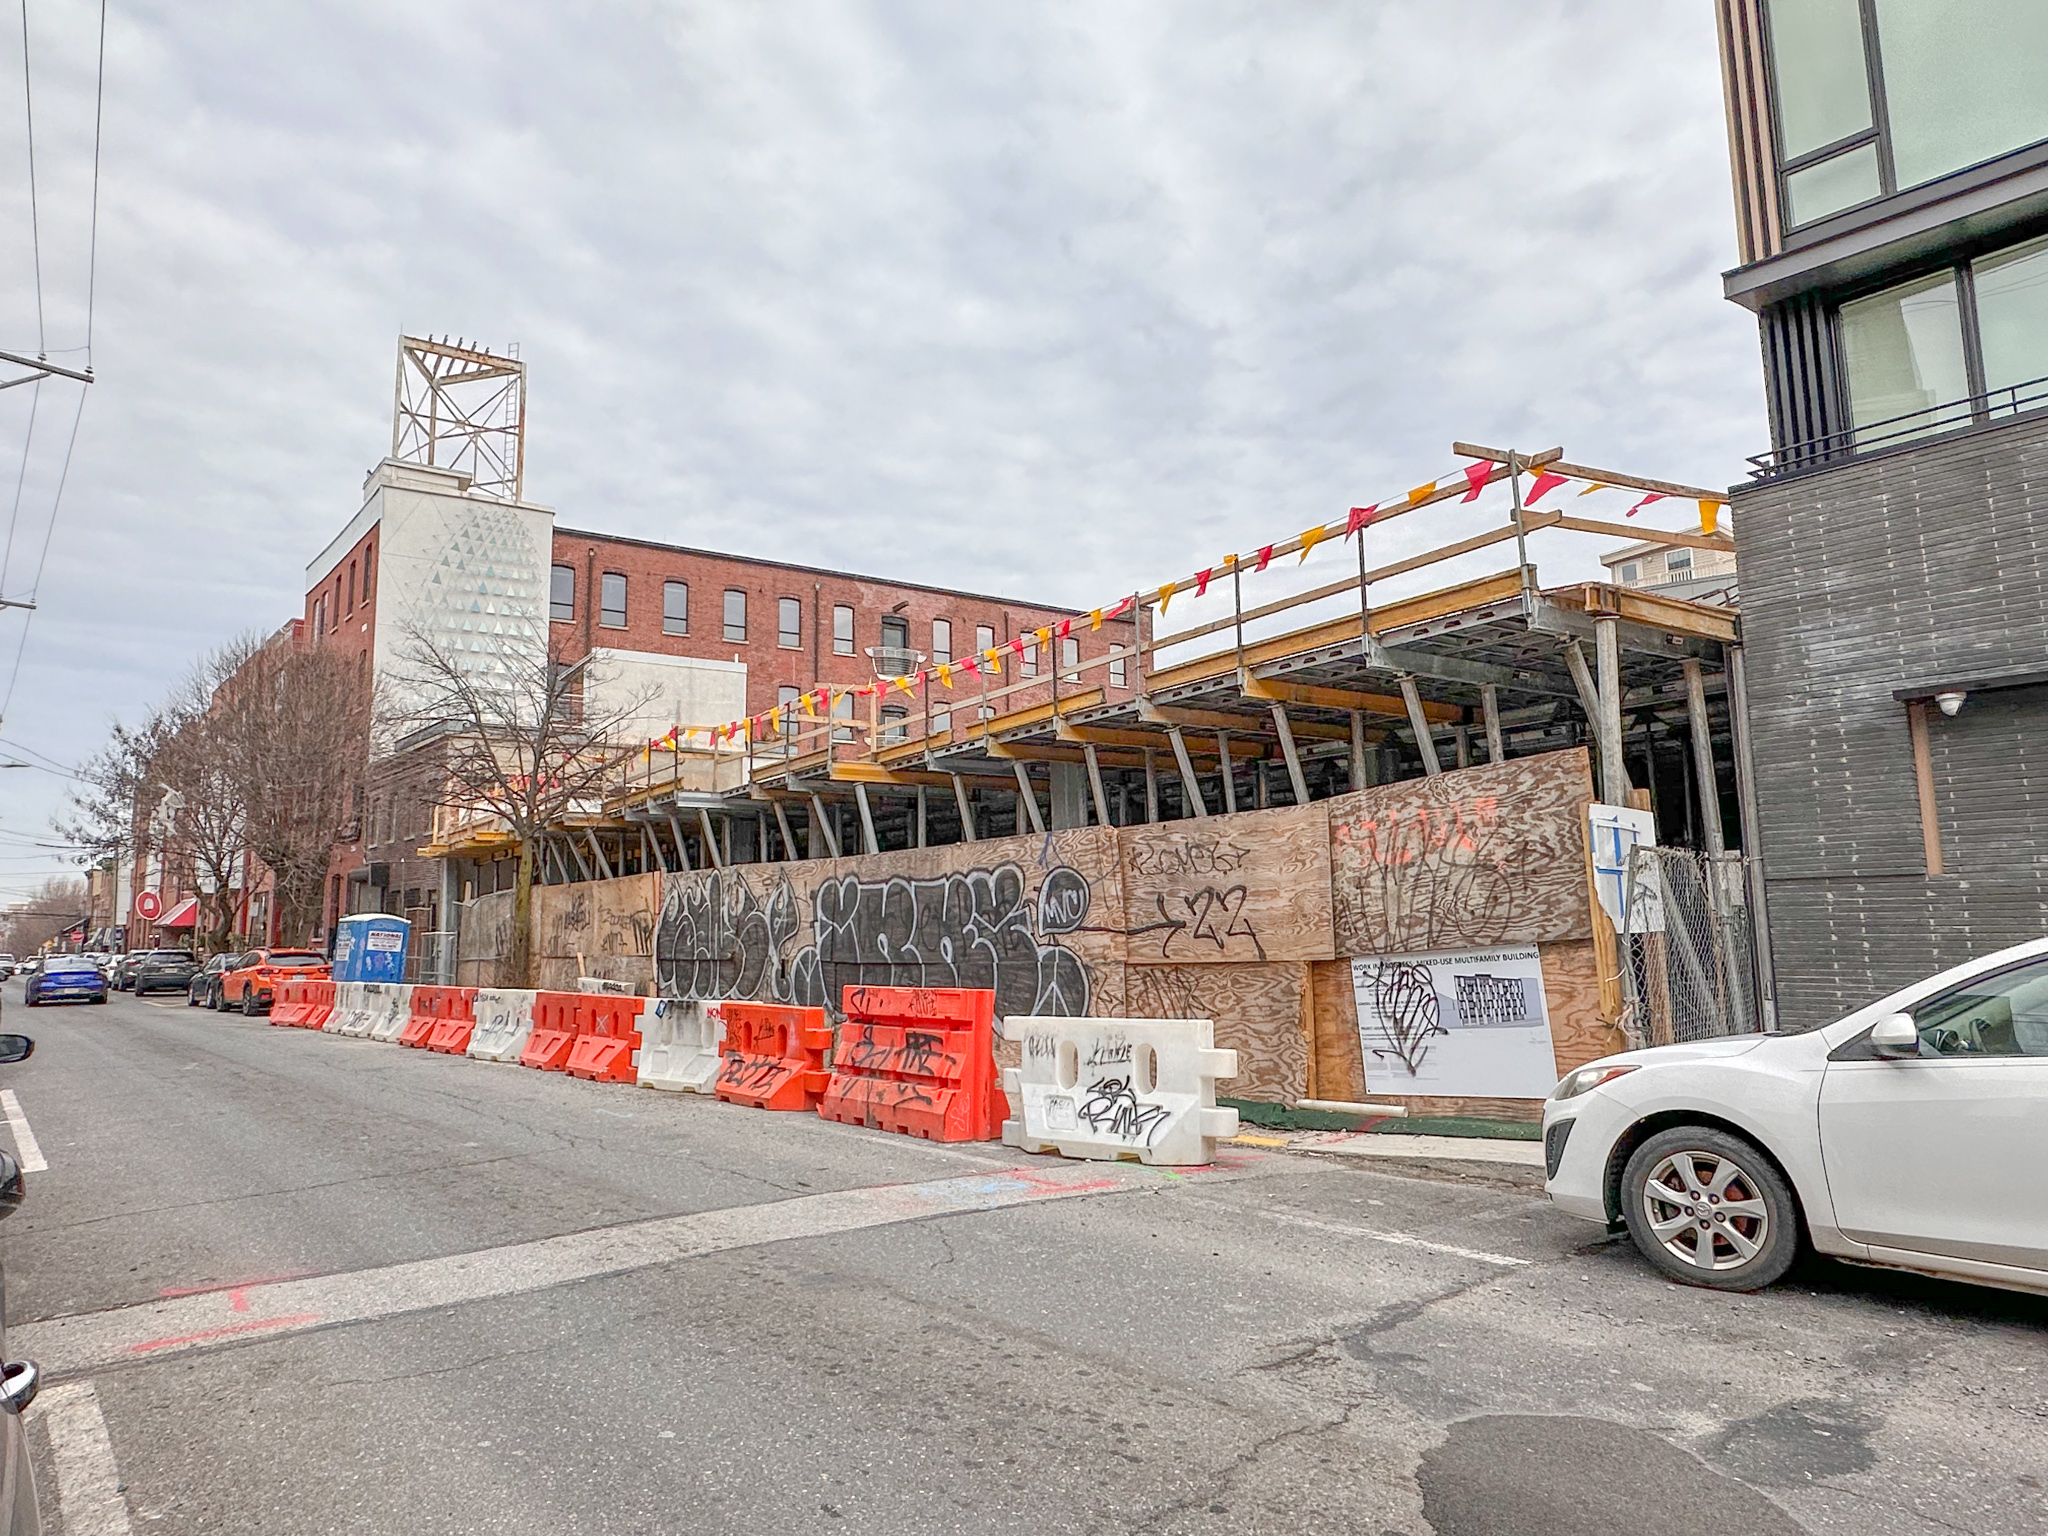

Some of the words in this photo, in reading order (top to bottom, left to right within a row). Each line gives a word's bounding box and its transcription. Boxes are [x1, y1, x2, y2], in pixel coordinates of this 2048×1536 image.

[1416, 958, 1453, 966] MIXED-USE
[1454, 954, 1501, 964] MULTIFAMILY
[1502, 952, 1539, 961] BUILDING
